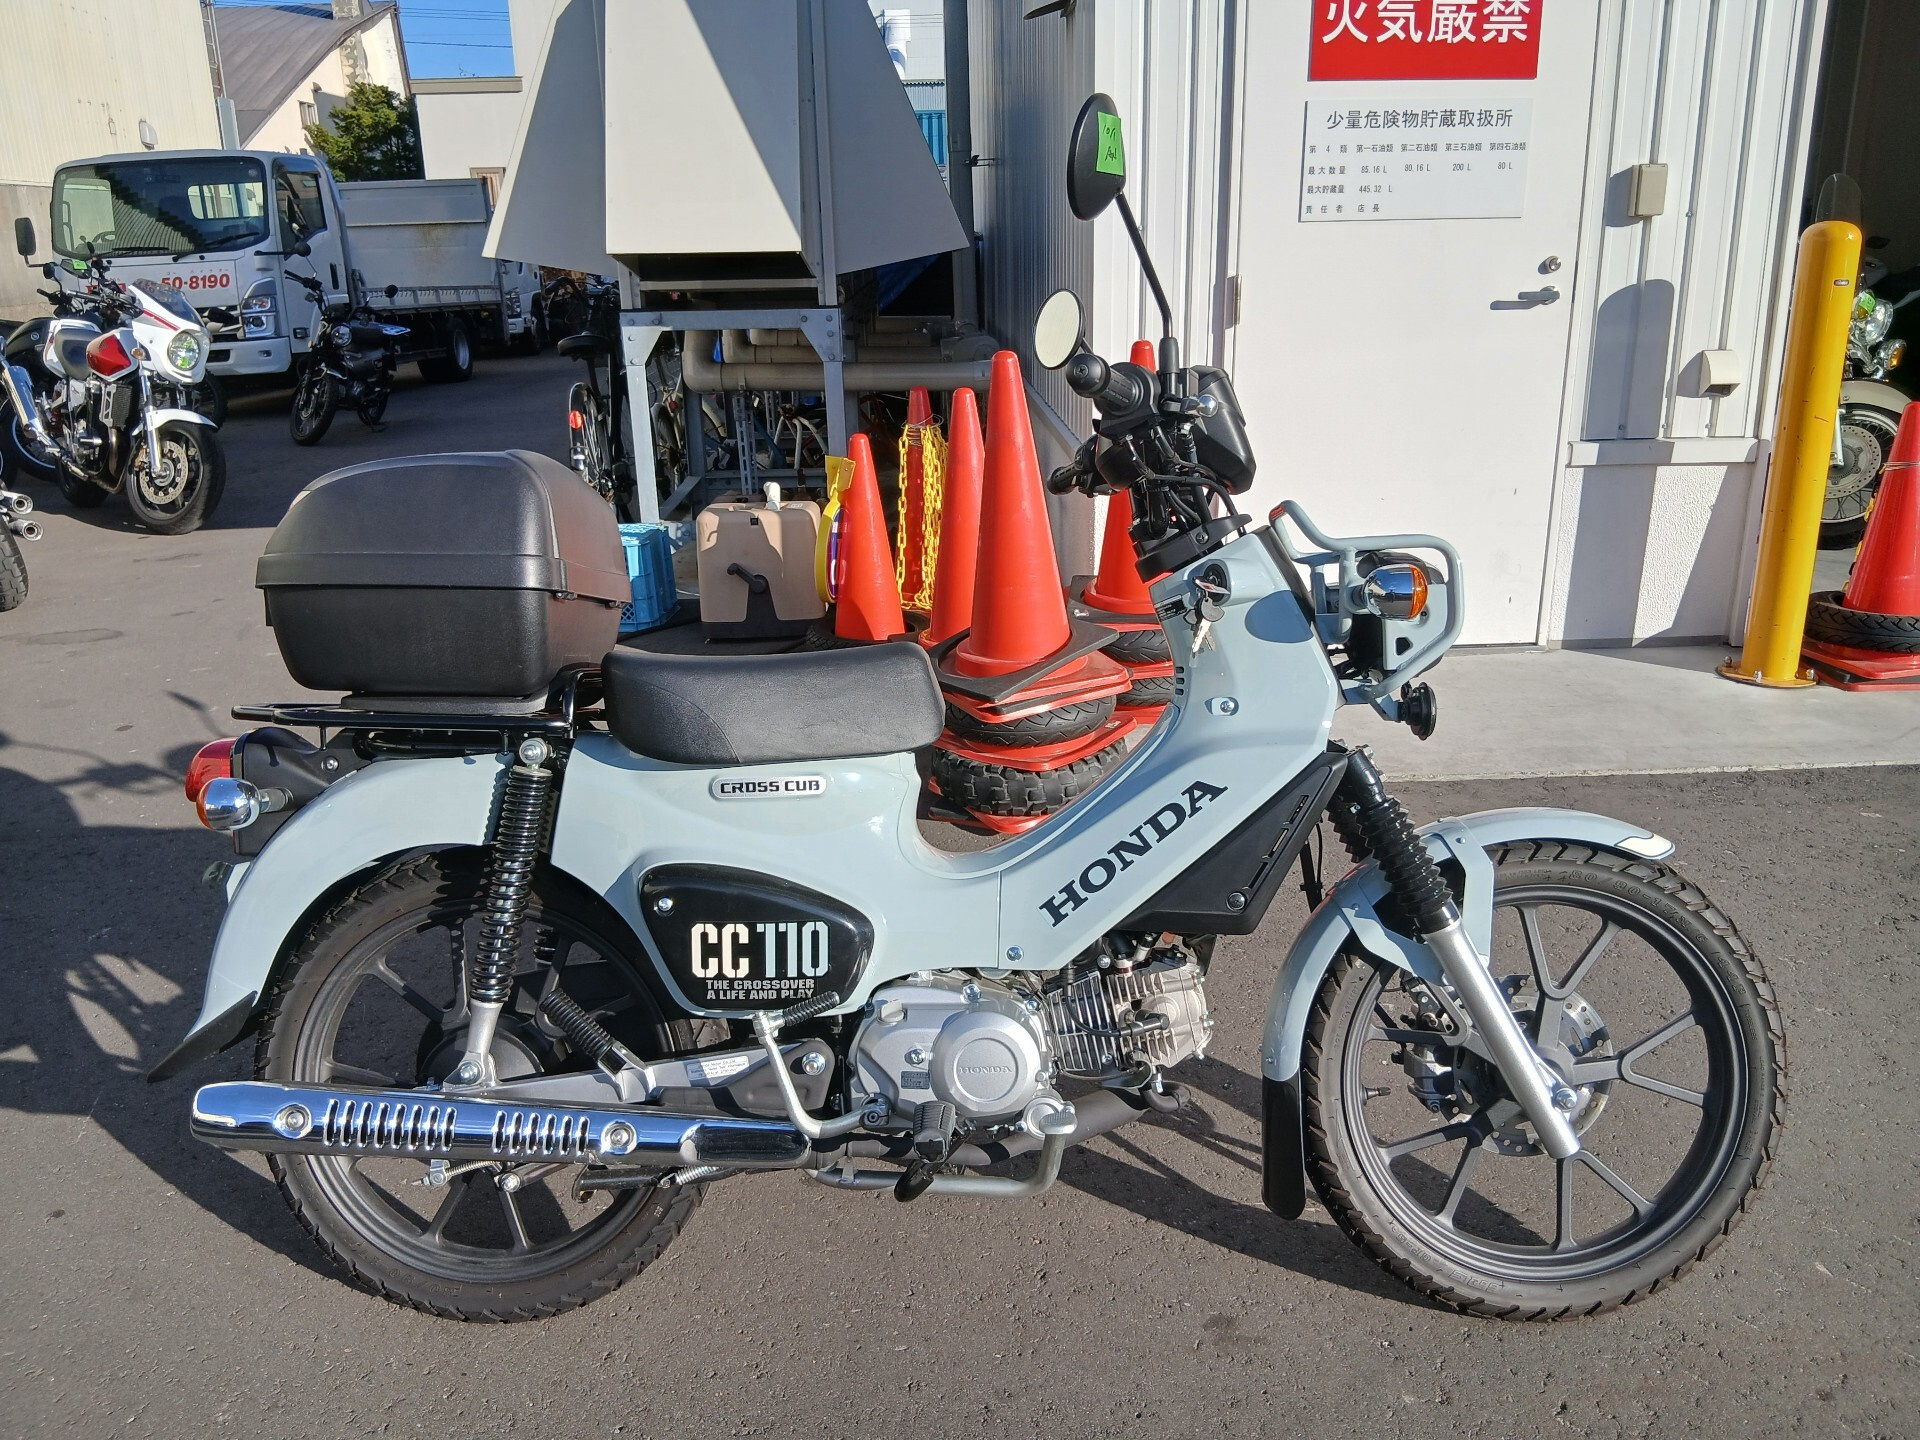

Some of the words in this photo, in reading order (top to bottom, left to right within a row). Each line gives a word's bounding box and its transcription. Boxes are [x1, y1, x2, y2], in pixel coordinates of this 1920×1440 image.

[1322, 0, 1530, 44] 火気厳禁
[1326, 108, 1513, 129] 少量危険物貯蔵取扱所
[720, 781, 780, 794] CROSS
[784, 780, 820, 792] CUB
[1038, 780, 1229, 928] HONDA
[706, 979, 730, 990] THE
[733, 978, 815, 990] CROSSOVER
[706, 990, 716, 1000] A
[719, 990, 746, 1000] LIFE
[749, 990, 777, 1000] AND
[781, 988, 814, 1000] PLAY
[959, 1065, 1013, 1074] HONDA
